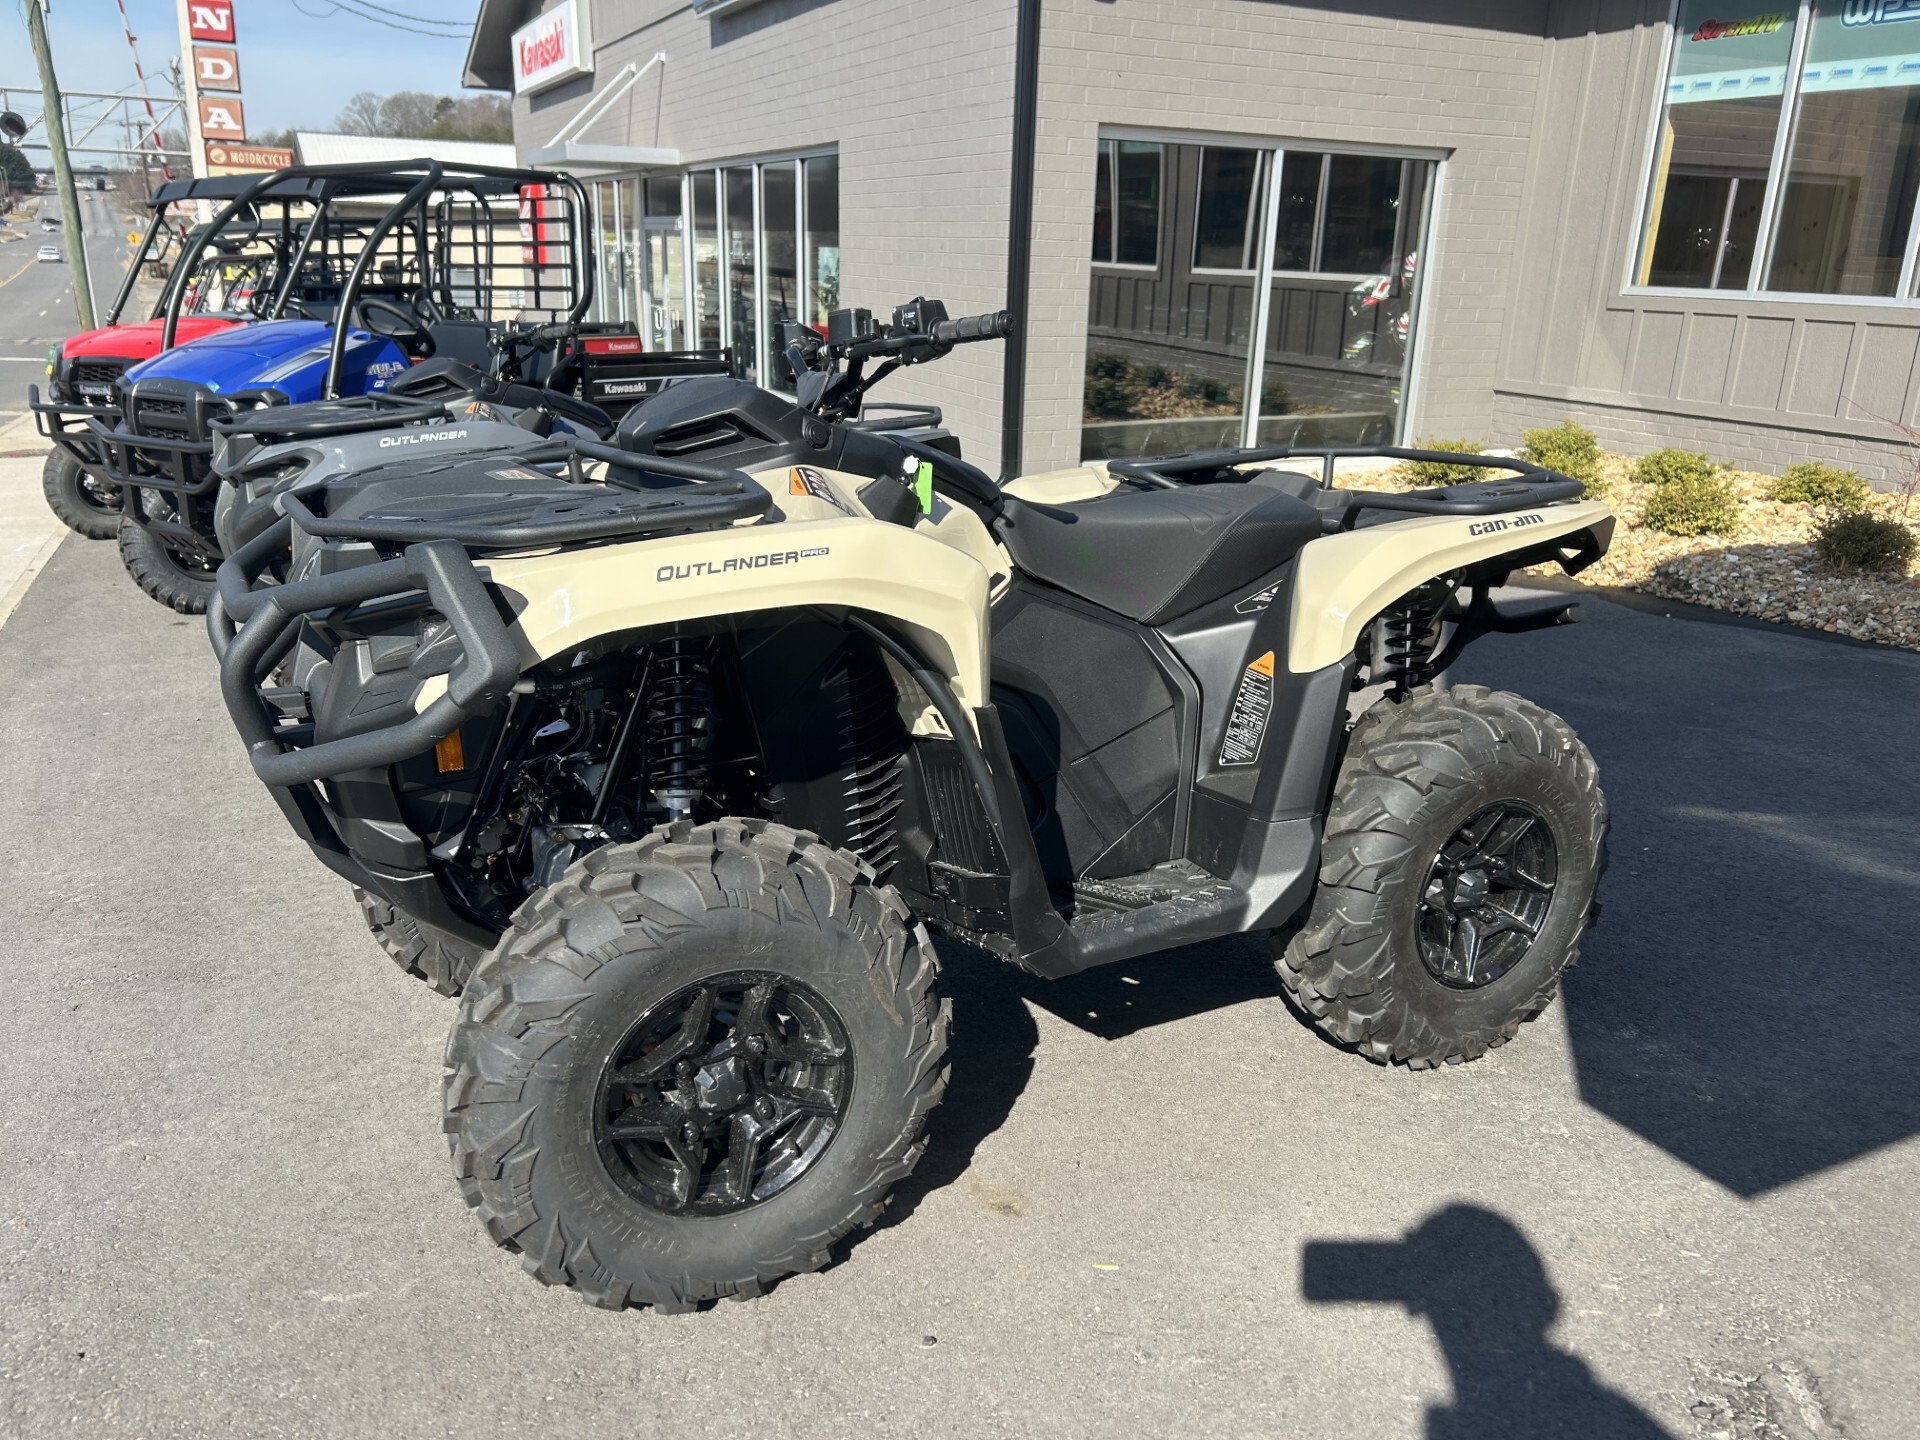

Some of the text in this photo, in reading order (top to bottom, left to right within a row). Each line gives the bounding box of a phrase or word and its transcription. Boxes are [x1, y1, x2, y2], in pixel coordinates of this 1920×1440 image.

[520, 18, 565, 77] Kawasaki
[230, 151, 291, 166] MOTORCYCLE
[608, 342, 638, 351] Kawasaki
[604, 381, 646, 394] Kawasaki
[379, 430, 468, 448] OUTLANDER
[1468, 514, 1544, 536] can-am
[656, 547, 830, 582] OUTLANDER PRO
